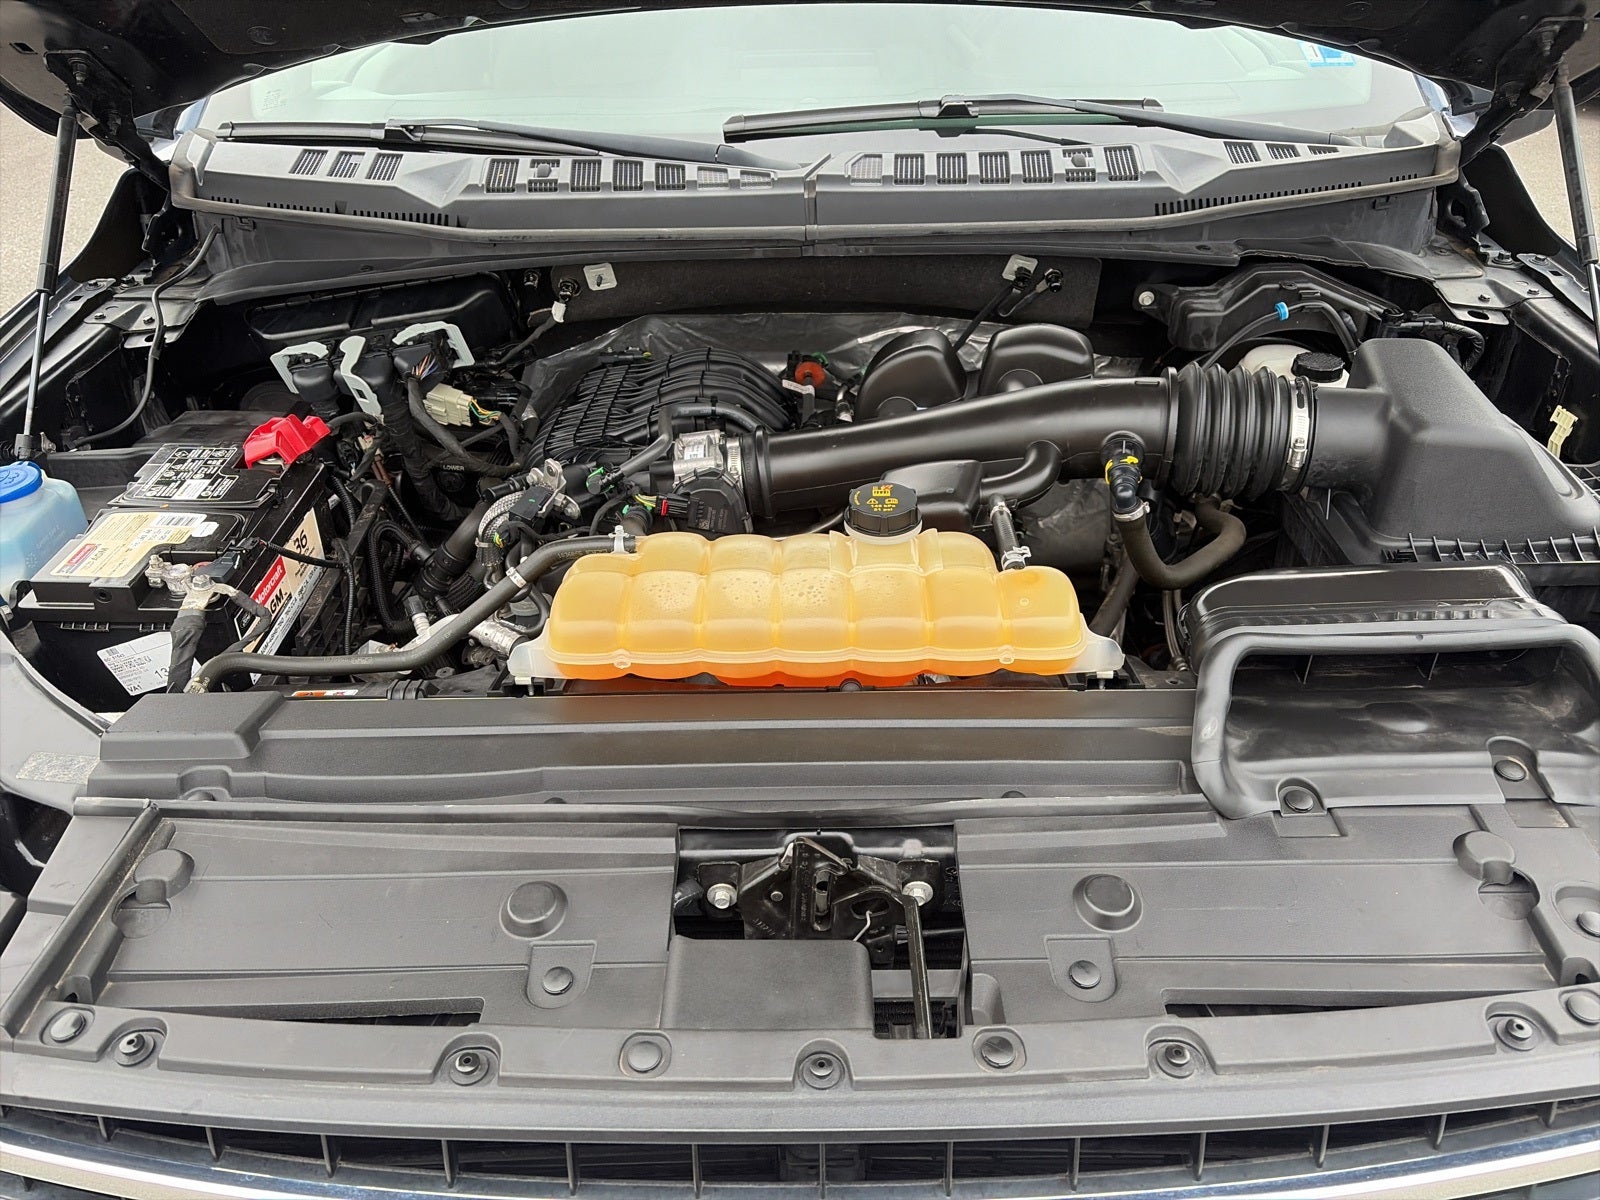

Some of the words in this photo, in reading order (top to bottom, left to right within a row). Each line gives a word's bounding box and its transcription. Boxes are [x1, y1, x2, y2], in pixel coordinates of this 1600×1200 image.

[293, 529, 308, 555] 36
[255, 564, 283, 605] Motorcraft
[269, 587, 284, 615] GM
[154, 667, 170, 679] 13
